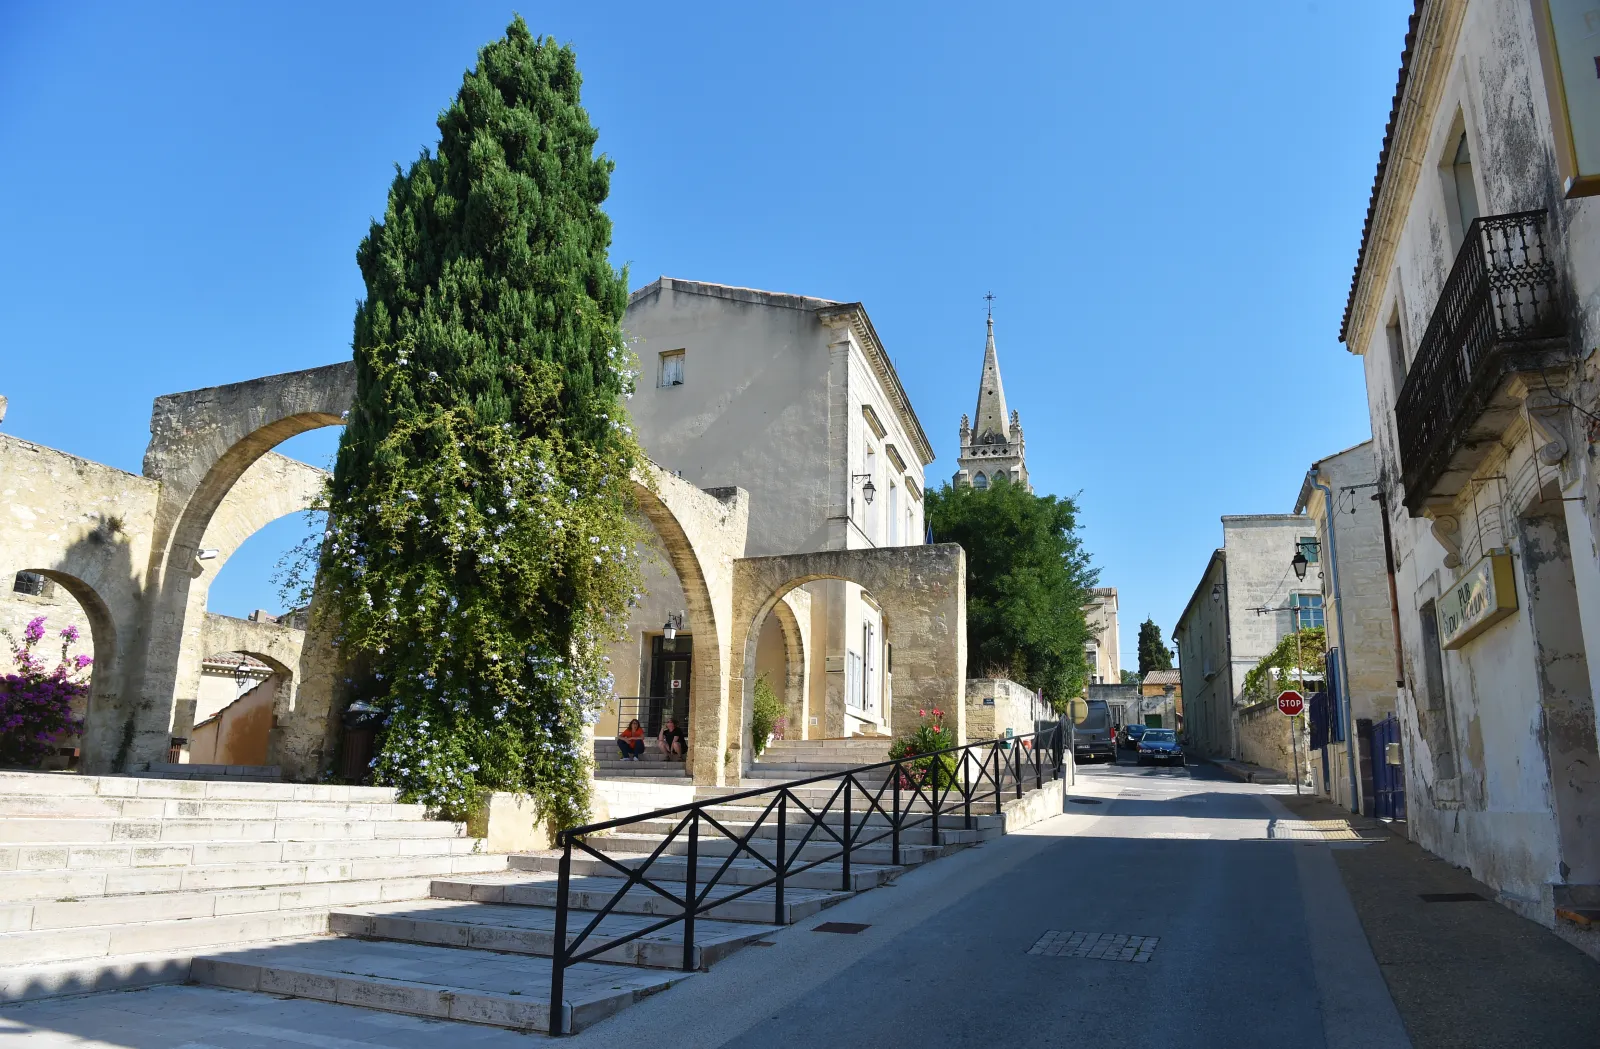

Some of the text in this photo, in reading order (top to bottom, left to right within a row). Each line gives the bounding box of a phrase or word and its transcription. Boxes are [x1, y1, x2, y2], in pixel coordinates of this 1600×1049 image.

[1458, 583, 1470, 606] PUB
[1449, 611, 1459, 633] DU
[1280, 699, 1301, 707] STOP
